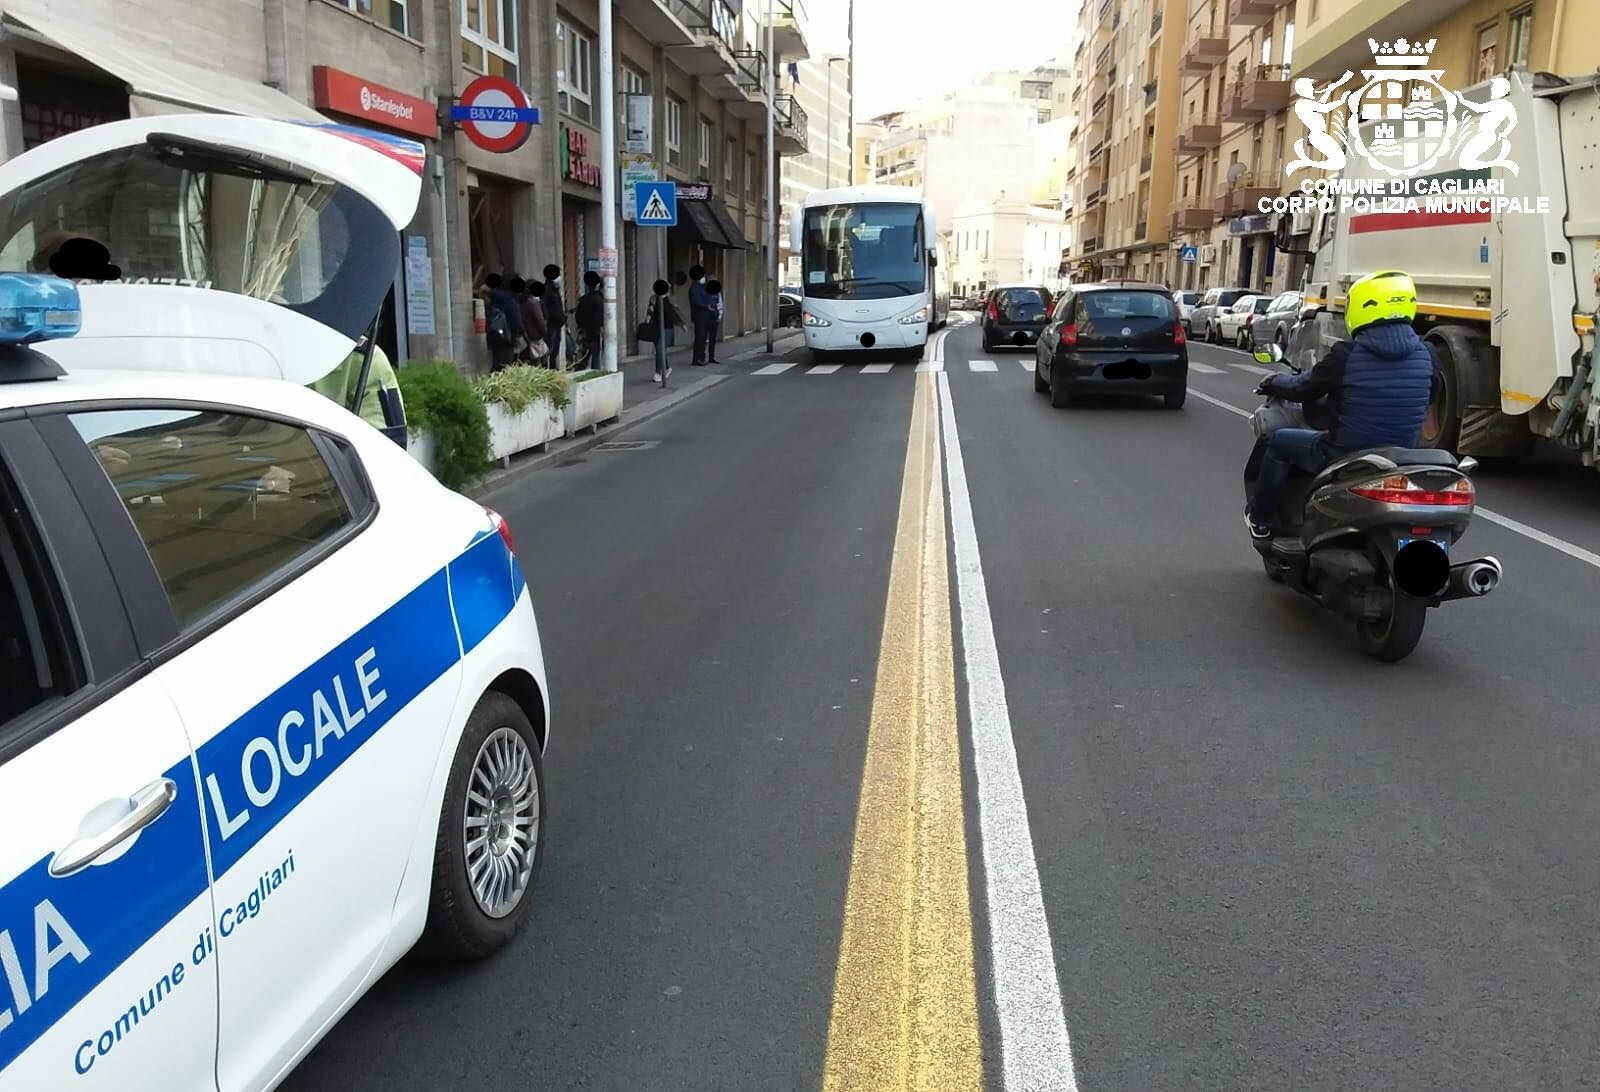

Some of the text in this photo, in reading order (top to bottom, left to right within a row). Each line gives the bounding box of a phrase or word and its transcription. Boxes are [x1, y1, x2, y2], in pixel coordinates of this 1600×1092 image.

[371, 93, 413, 120] Stanleybet
[470, 108, 519, 121] B&V 24h
[205, 646, 388, 841] LOCALE
[74, 849, 295, 1075] Comune di Cagliari
